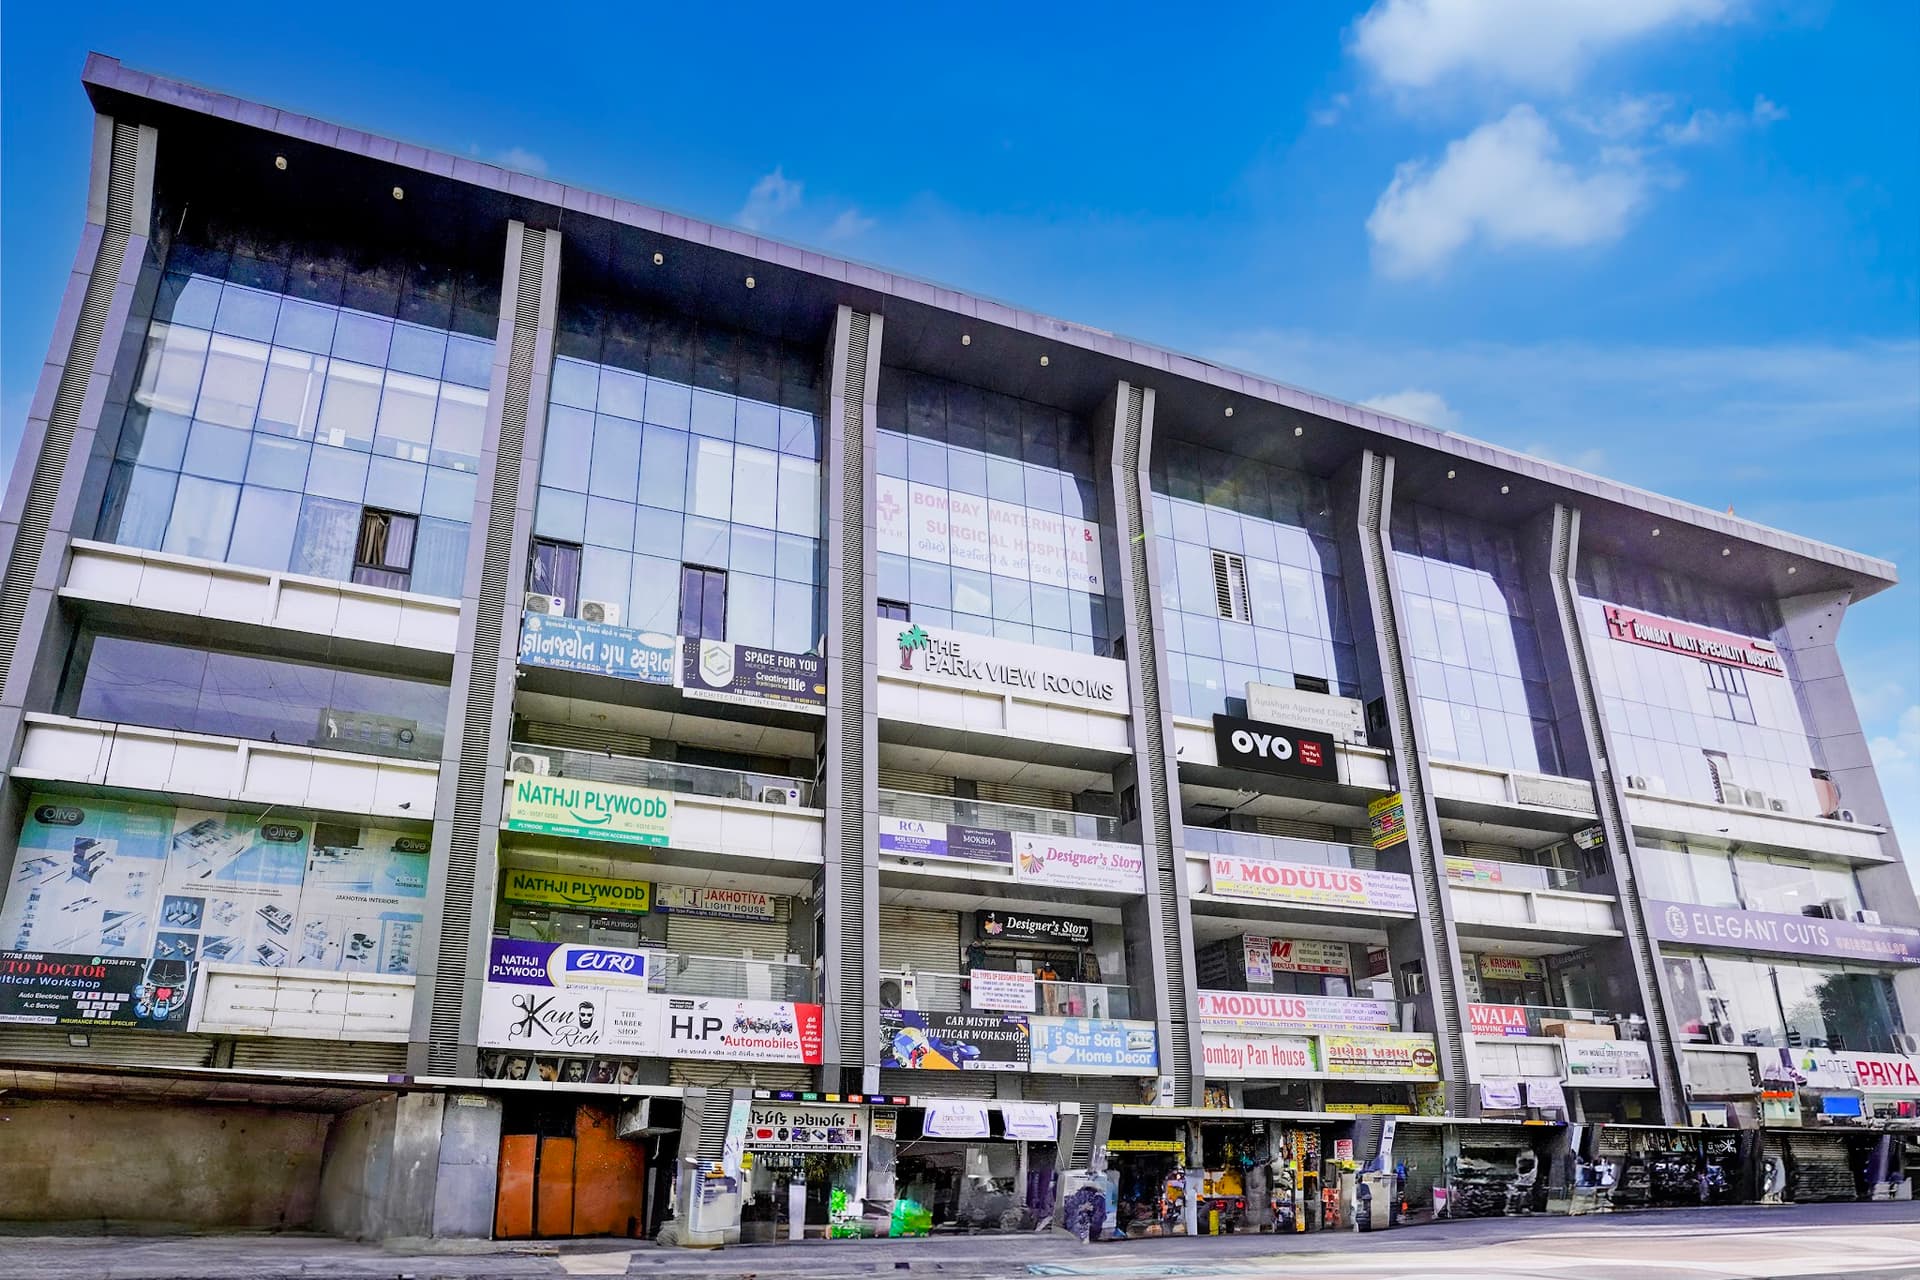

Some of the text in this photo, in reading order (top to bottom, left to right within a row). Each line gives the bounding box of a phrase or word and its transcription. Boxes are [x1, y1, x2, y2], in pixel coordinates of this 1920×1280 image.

[914, 491, 1093, 542] BOMBAY MATERNITY &
[926, 520, 1088, 565] SURGICAL HOSPITAL
[1635, 621, 1669, 645] BOMBAY
[1670, 631, 1697, 652] MULTI
[927, 639, 960, 657] THE
[744, 650, 817, 672] SPACE FOR YOU
[788, 677, 806, 691] life
[924, 653, 1114, 700] PARK VIEW ROOMS
[1231, 730, 1293, 760] OYO
[518, 779, 580, 809] NATHJI
[43, 807, 78, 821] Olive
[268, 826, 298, 840] Olive
[899, 820, 925, 832] RCA
[402, 839, 427, 851] Olive
[894, 835, 931, 845] SOLUTIONS
[963, 835, 997, 846] MOKSHA
[1046, 847, 1142, 873] Designer's Story
[513, 874, 568, 894] NATHJI
[1216, 860, 1231, 874] M
[1240, 864, 1363, 893] MODULUS
[704, 889, 766, 905] JAKHOTIYA
[705, 902, 766, 914] LIGHT HOUSE
[611, 920, 638, 930] PLYWOOD
[1007, 916, 1088, 938] Designer's Story
[1692, 912, 1779, 942] ELEGANT
[1784, 922, 1829, 946] CUTS
[1271, 942, 1292, 958] M
[501, 954, 538, 966] NATHJI
[576, 952, 635, 973] EURO
[1490, 958, 1522, 969] KRISHNA
[35, 962, 106, 978] DOCTOR
[492, 965, 546, 978] PLYWOOD
[40, 976, 100, 988] Workshop
[35, 992, 69, 1001] Electrician
[1211, 996, 1306, 1018] MODULUS
[614, 1018, 643, 1027] BARBER
[670, 1015, 726, 1042] H.P.
[945, 1016, 966, 1026] CAR
[966, 1017, 1002, 1028] MISTRY
[1472, 1024, 1504, 1032] DRIVING
[551, 1025, 600, 1048] Rich
[724, 1034, 799, 1050] Automobiles
[921, 1028, 1025, 1042] MULTICAR WORKSHOP
[1056, 1031, 1121, 1047] 5 Star Sofa
[1076, 1048, 1152, 1064] Home Decor
[1247, 1044, 1269, 1065] Pan
[1272, 1044, 1306, 1066] House
[1819, 1060, 1920, 1086] HOTEL PRIYA
